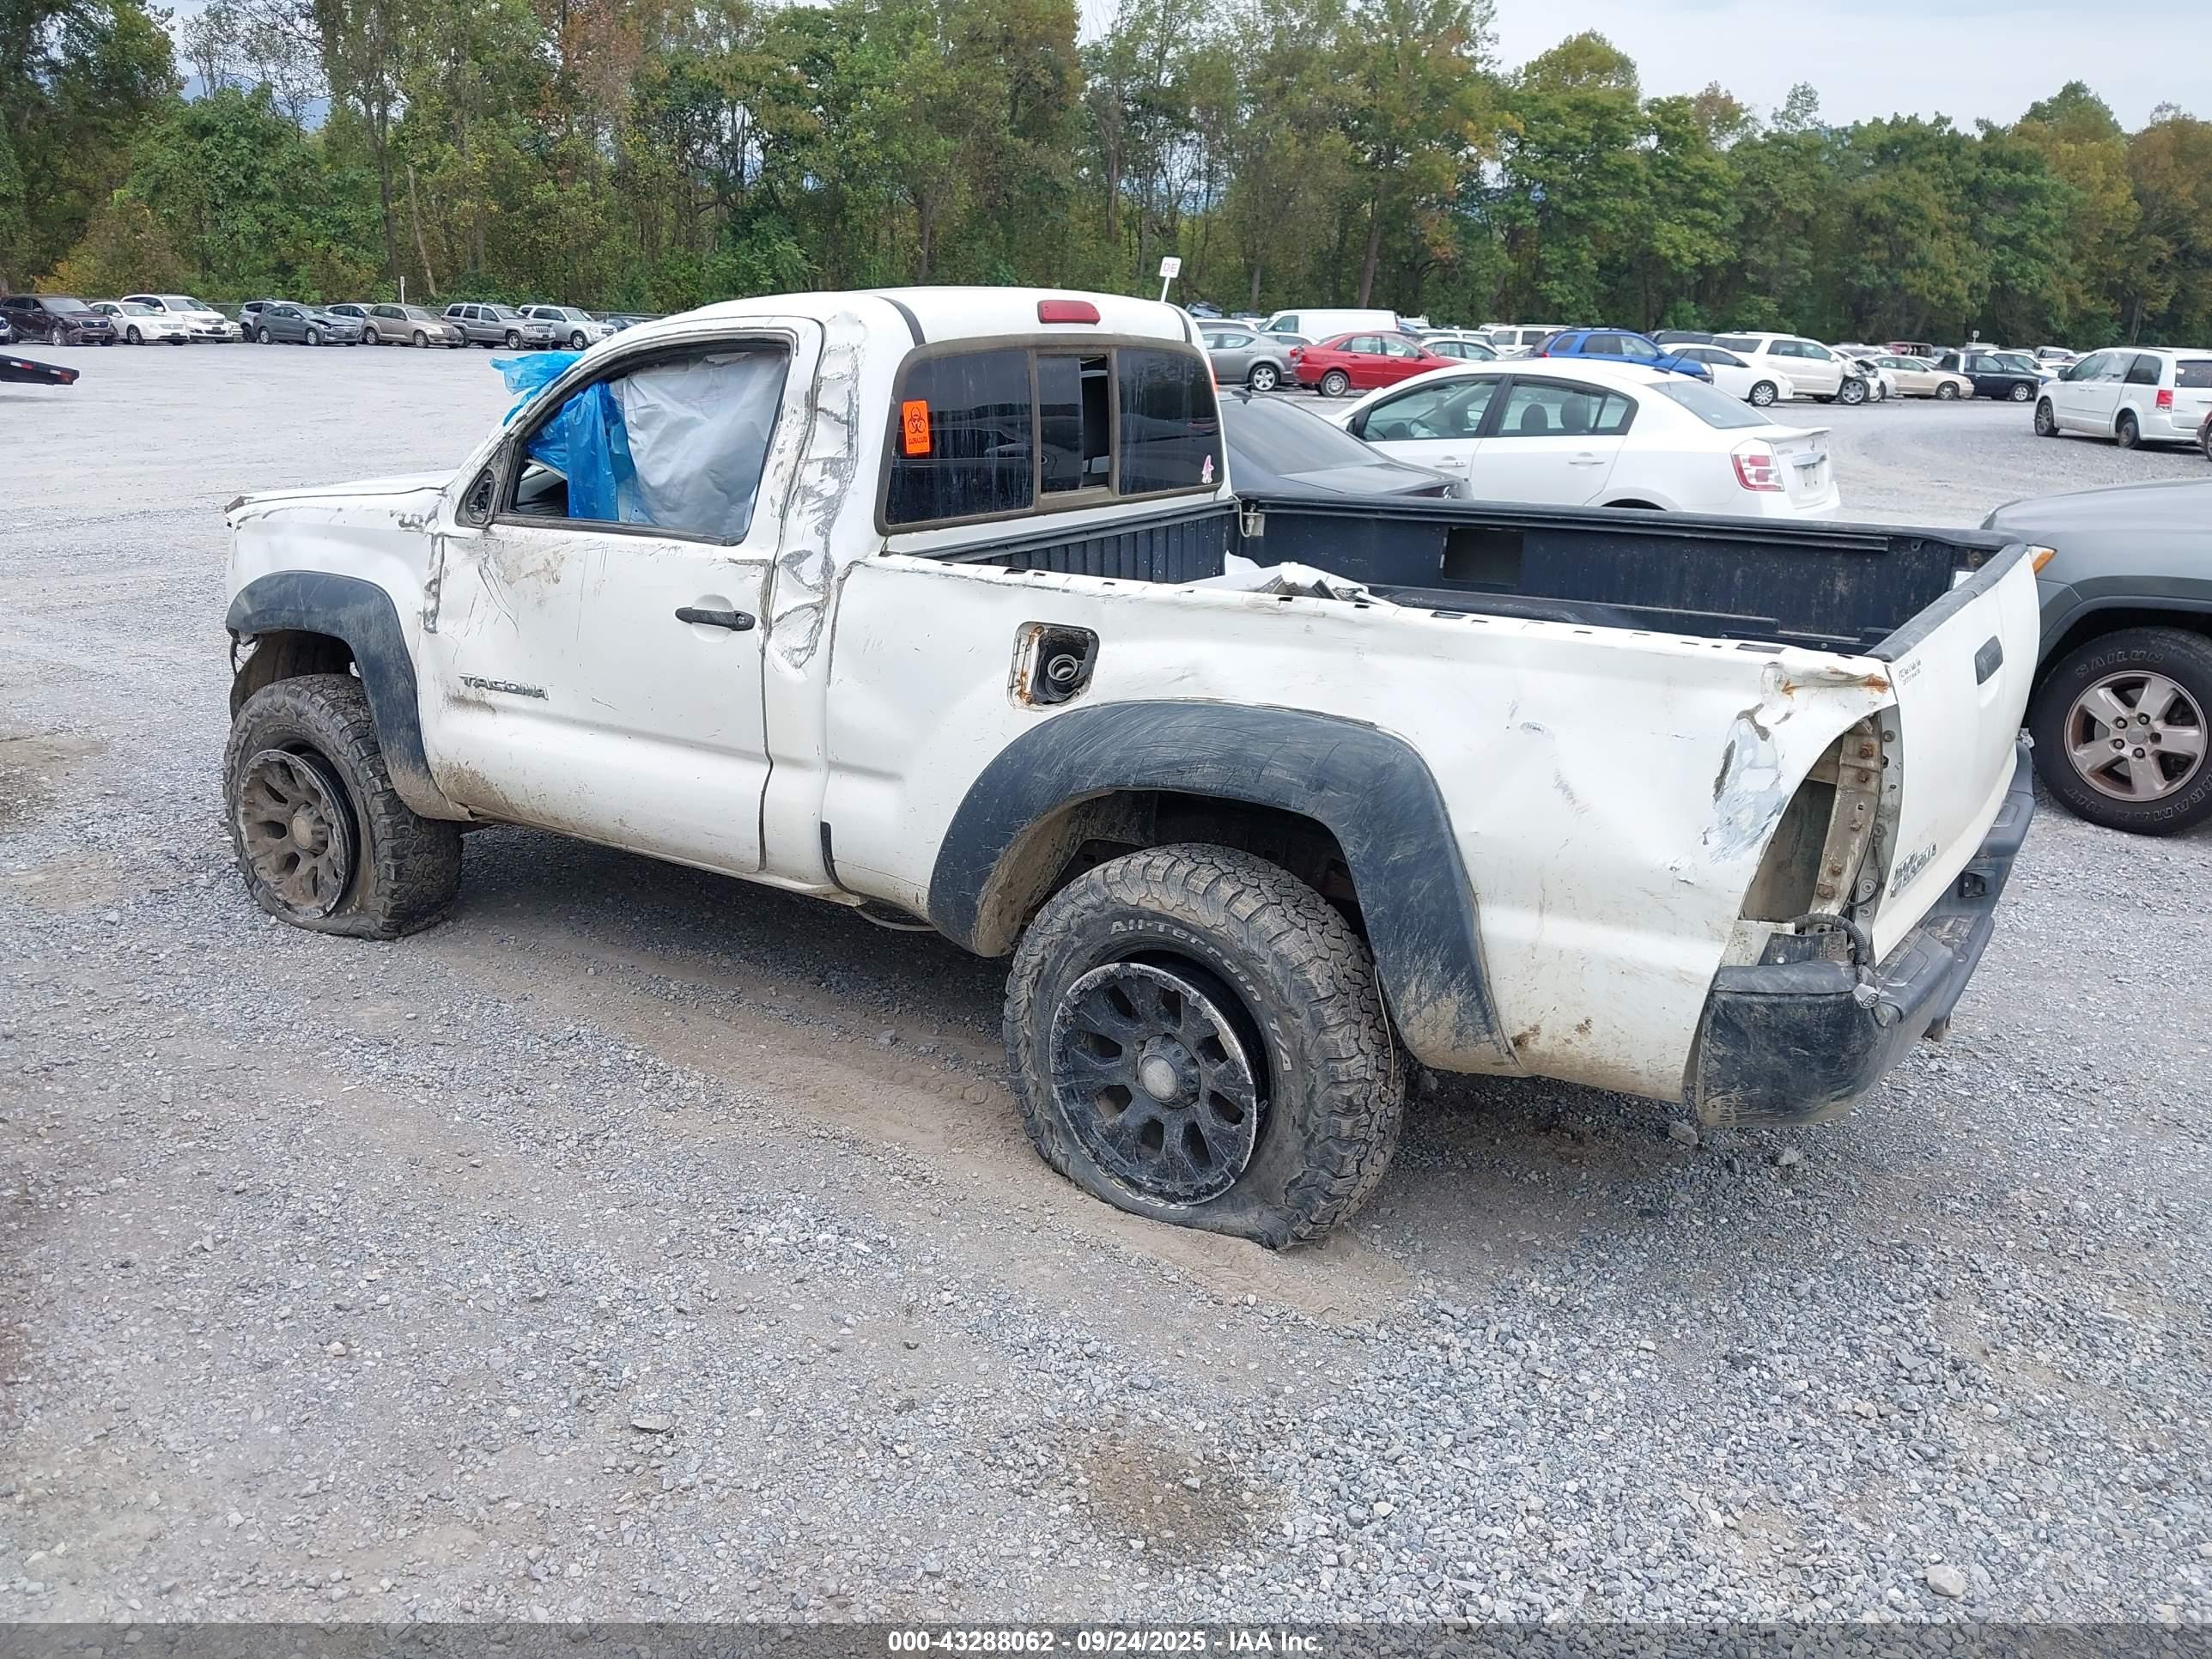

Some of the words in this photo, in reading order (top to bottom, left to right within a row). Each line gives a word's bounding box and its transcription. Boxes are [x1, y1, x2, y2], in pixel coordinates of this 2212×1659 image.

[2075, 649, 2165, 678] SAILUN
[458, 673, 550, 701] TACOMA
[1109, 919, 1261, 1002] All-Terrain
